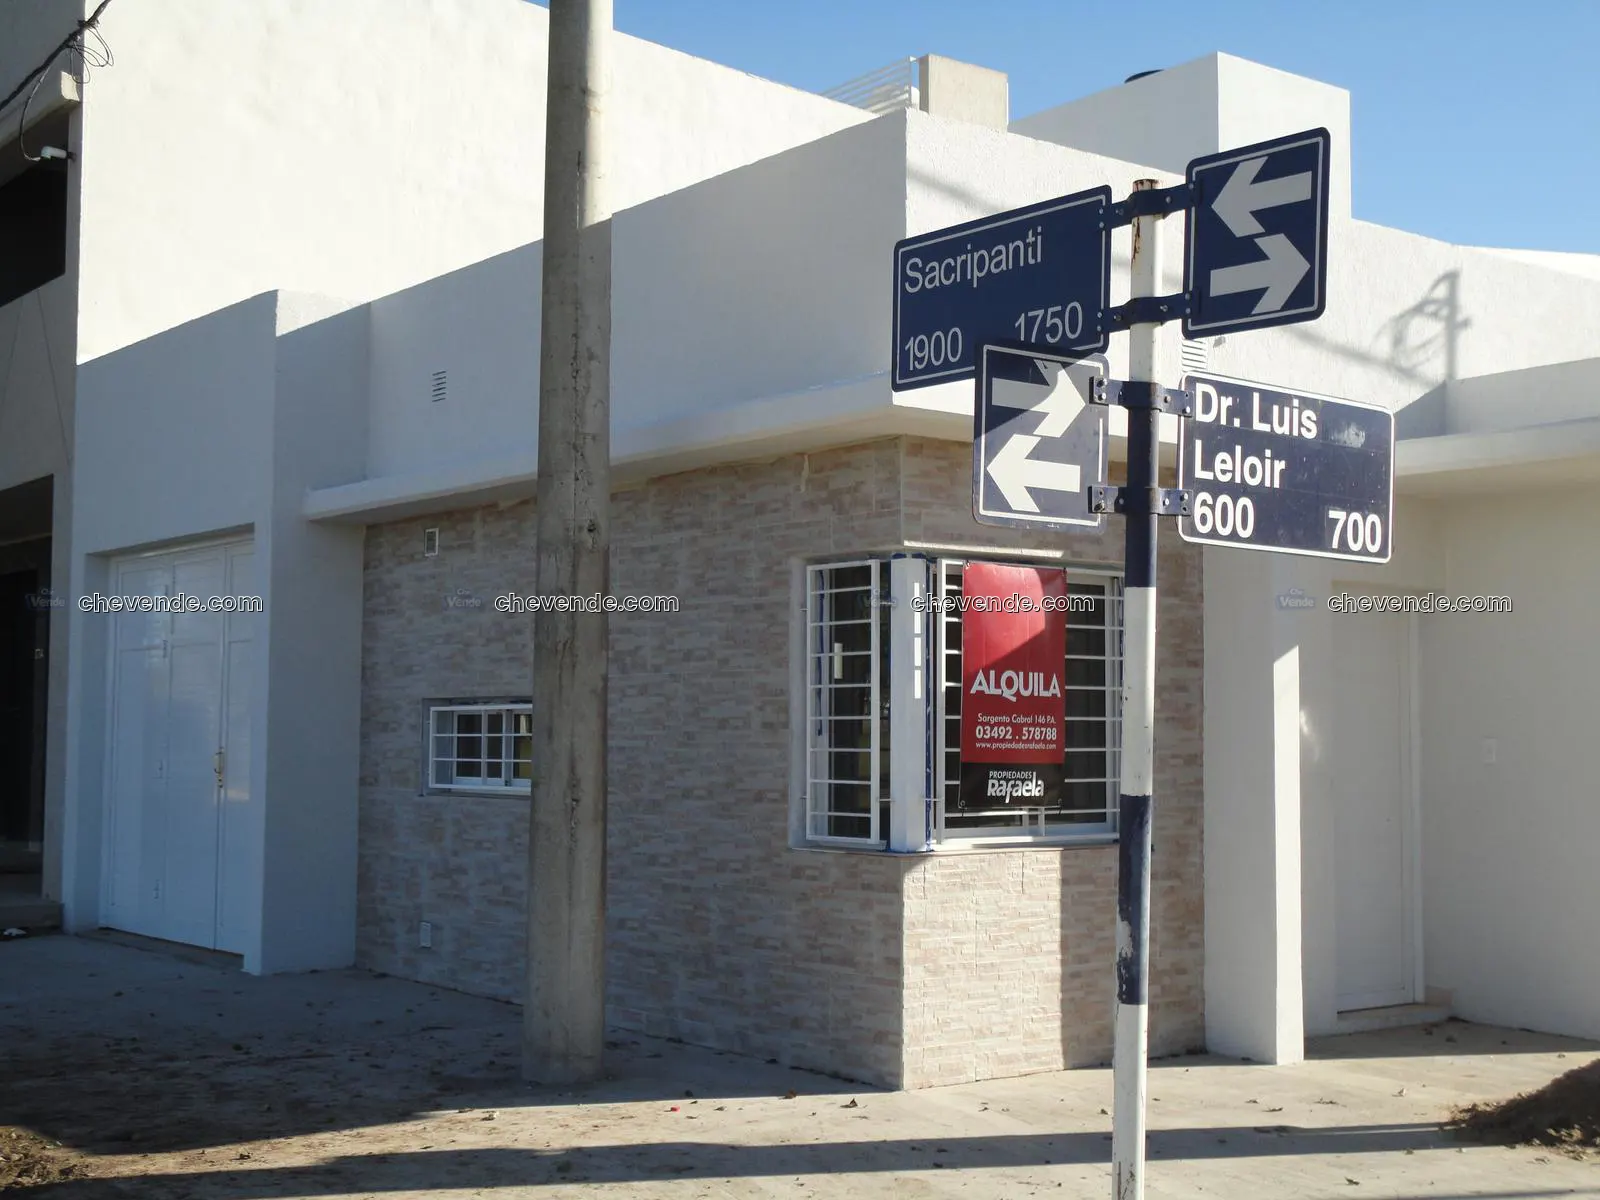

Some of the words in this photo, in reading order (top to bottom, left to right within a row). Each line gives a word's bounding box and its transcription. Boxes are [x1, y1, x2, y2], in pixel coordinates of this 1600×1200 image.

[904, 226, 1043, 294] Sacripanti
[904, 327, 964, 371] 1900
[1014, 301, 1083, 343] 1750
[1194, 383, 1241, 427] Dr.
[1252, 391, 1318, 440] Luis
[1193, 439, 1286, 489] Leloir
[1193, 496, 1255, 539] 600
[1328, 509, 1382, 553] 700
[970, 669, 1061, 702] ALQUILA
[975, 725, 1013, 740] 03492
[1021, 727, 1057, 740] 578788
[977, 713, 1010, 723] Sargento
[1011, 713, 1033, 723] Cabral
[1035, 715, 1046, 723] 146
[987, 771, 1045, 804] Rafaela
[989, 770, 1033, 779] PROPIEDADES
